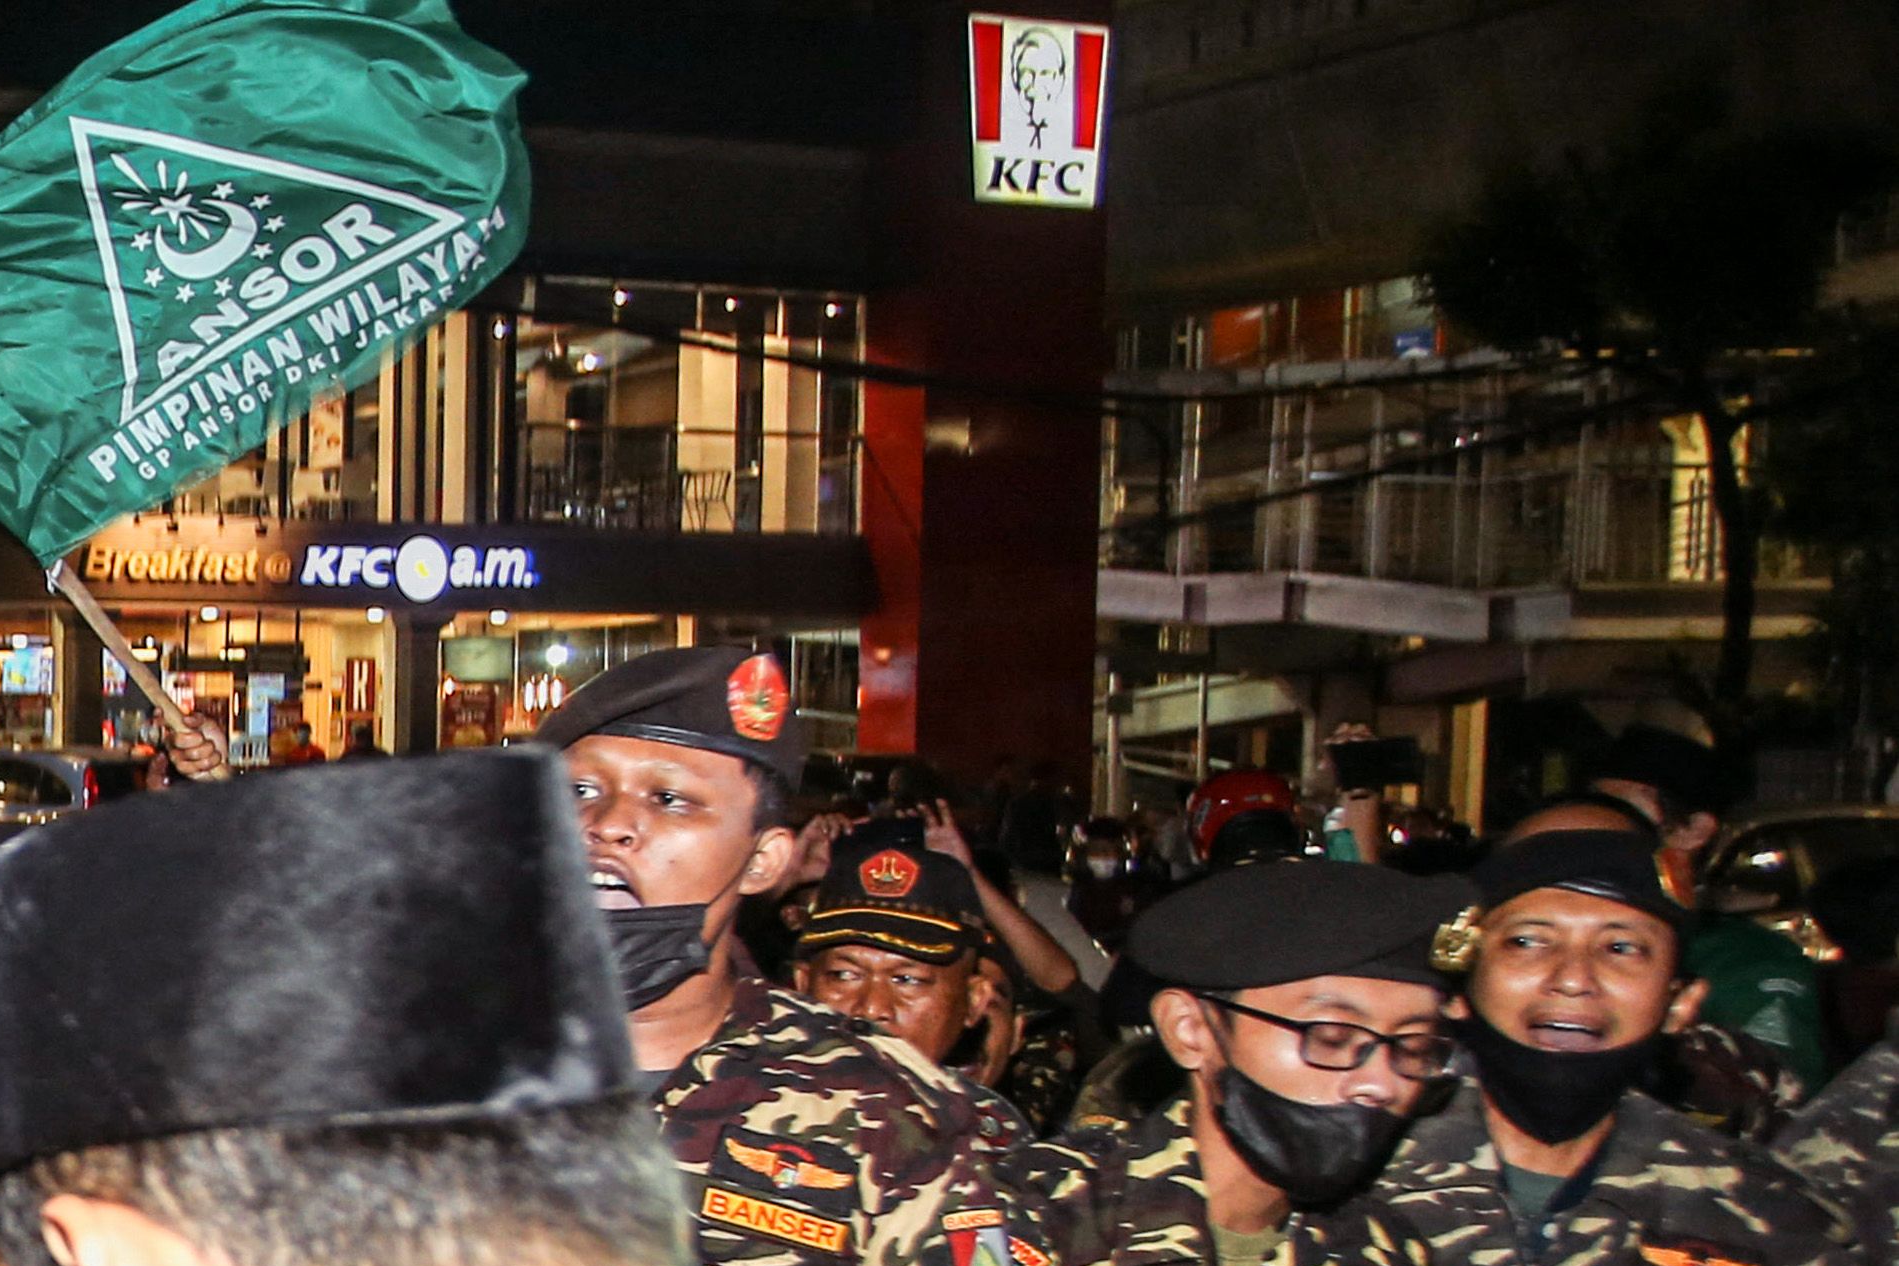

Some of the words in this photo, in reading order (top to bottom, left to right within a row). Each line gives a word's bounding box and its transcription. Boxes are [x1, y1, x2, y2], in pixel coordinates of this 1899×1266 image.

[987, 157, 1084, 196] KFC
[157, 203, 397, 380] ANSOR
[88, 327, 303, 483] PIMPINAN
[138, 449, 171, 480] GP
[182, 381, 273, 450] ANSOR
[285, 346, 340, 384] DKI
[84, 544, 260, 582] Breakfast
[301, 545, 394, 587] KFC
[450, 546, 534, 588] a.m.
[708, 1193, 836, 1247] BANSER
